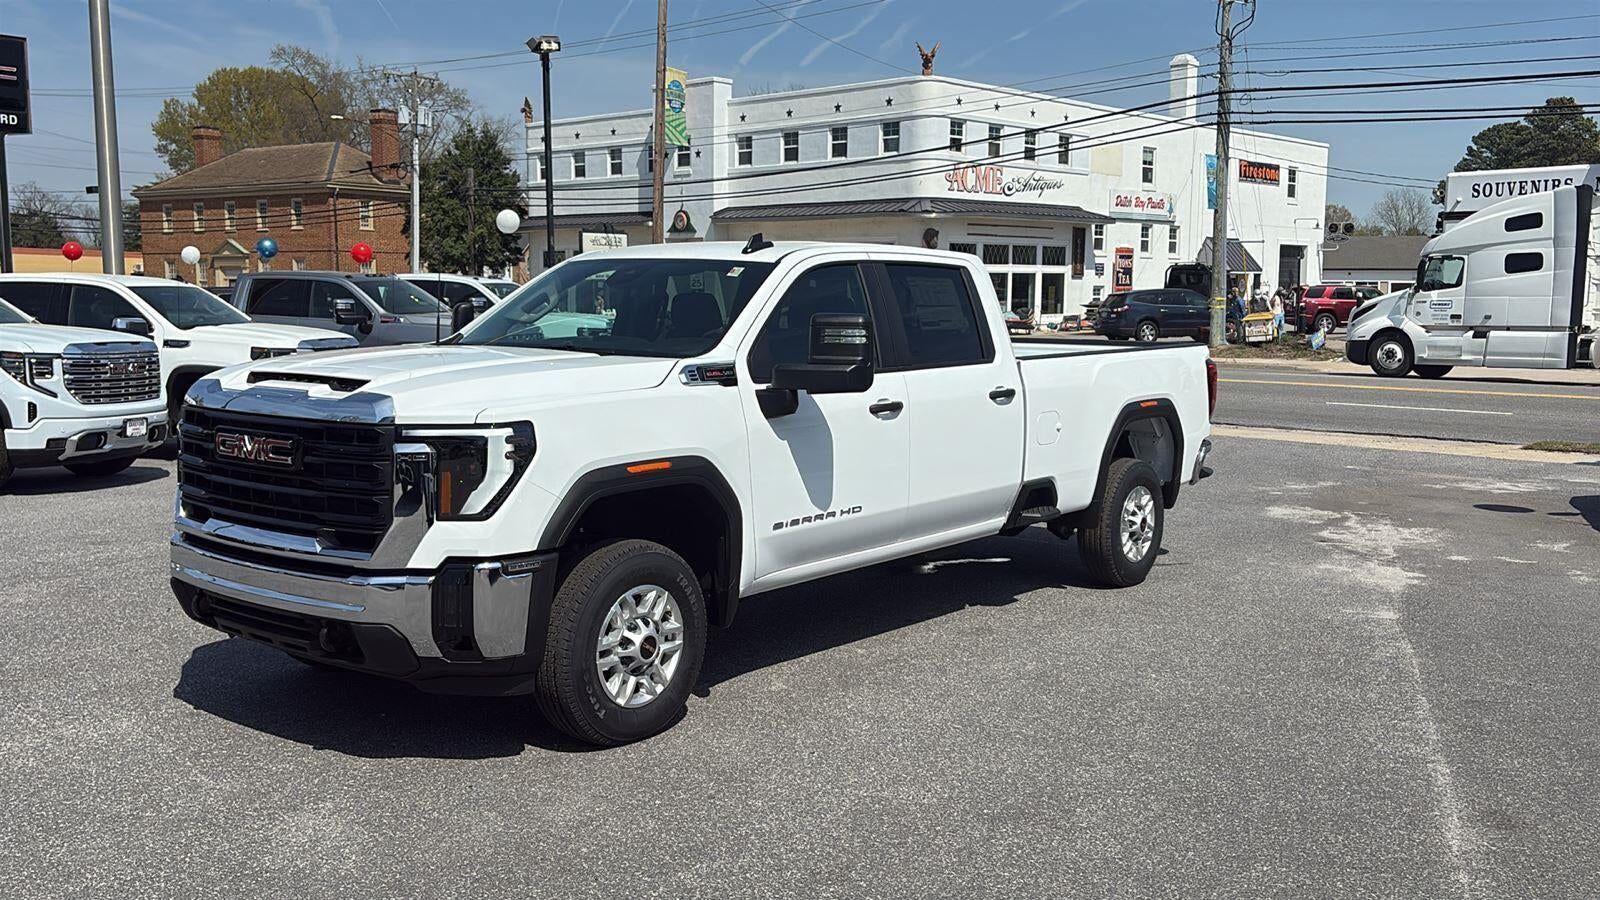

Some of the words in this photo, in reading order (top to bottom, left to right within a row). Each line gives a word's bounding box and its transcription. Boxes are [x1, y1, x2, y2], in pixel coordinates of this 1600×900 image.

[945, 164, 1004, 195] ACME
[1015, 170, 1064, 198] Antiques
[1240, 160, 1279, 181] Firestone
[1115, 194, 1133, 208] Dutch
[1134, 196, 1147, 212] Boy
[1147, 197, 1166, 210] Paints
[1117, 273, 1131, 285] TEA
[216, 433, 293, 464] GMC
[772, 510, 837, 531] SIERRA
[840, 505, 862, 516] HD
